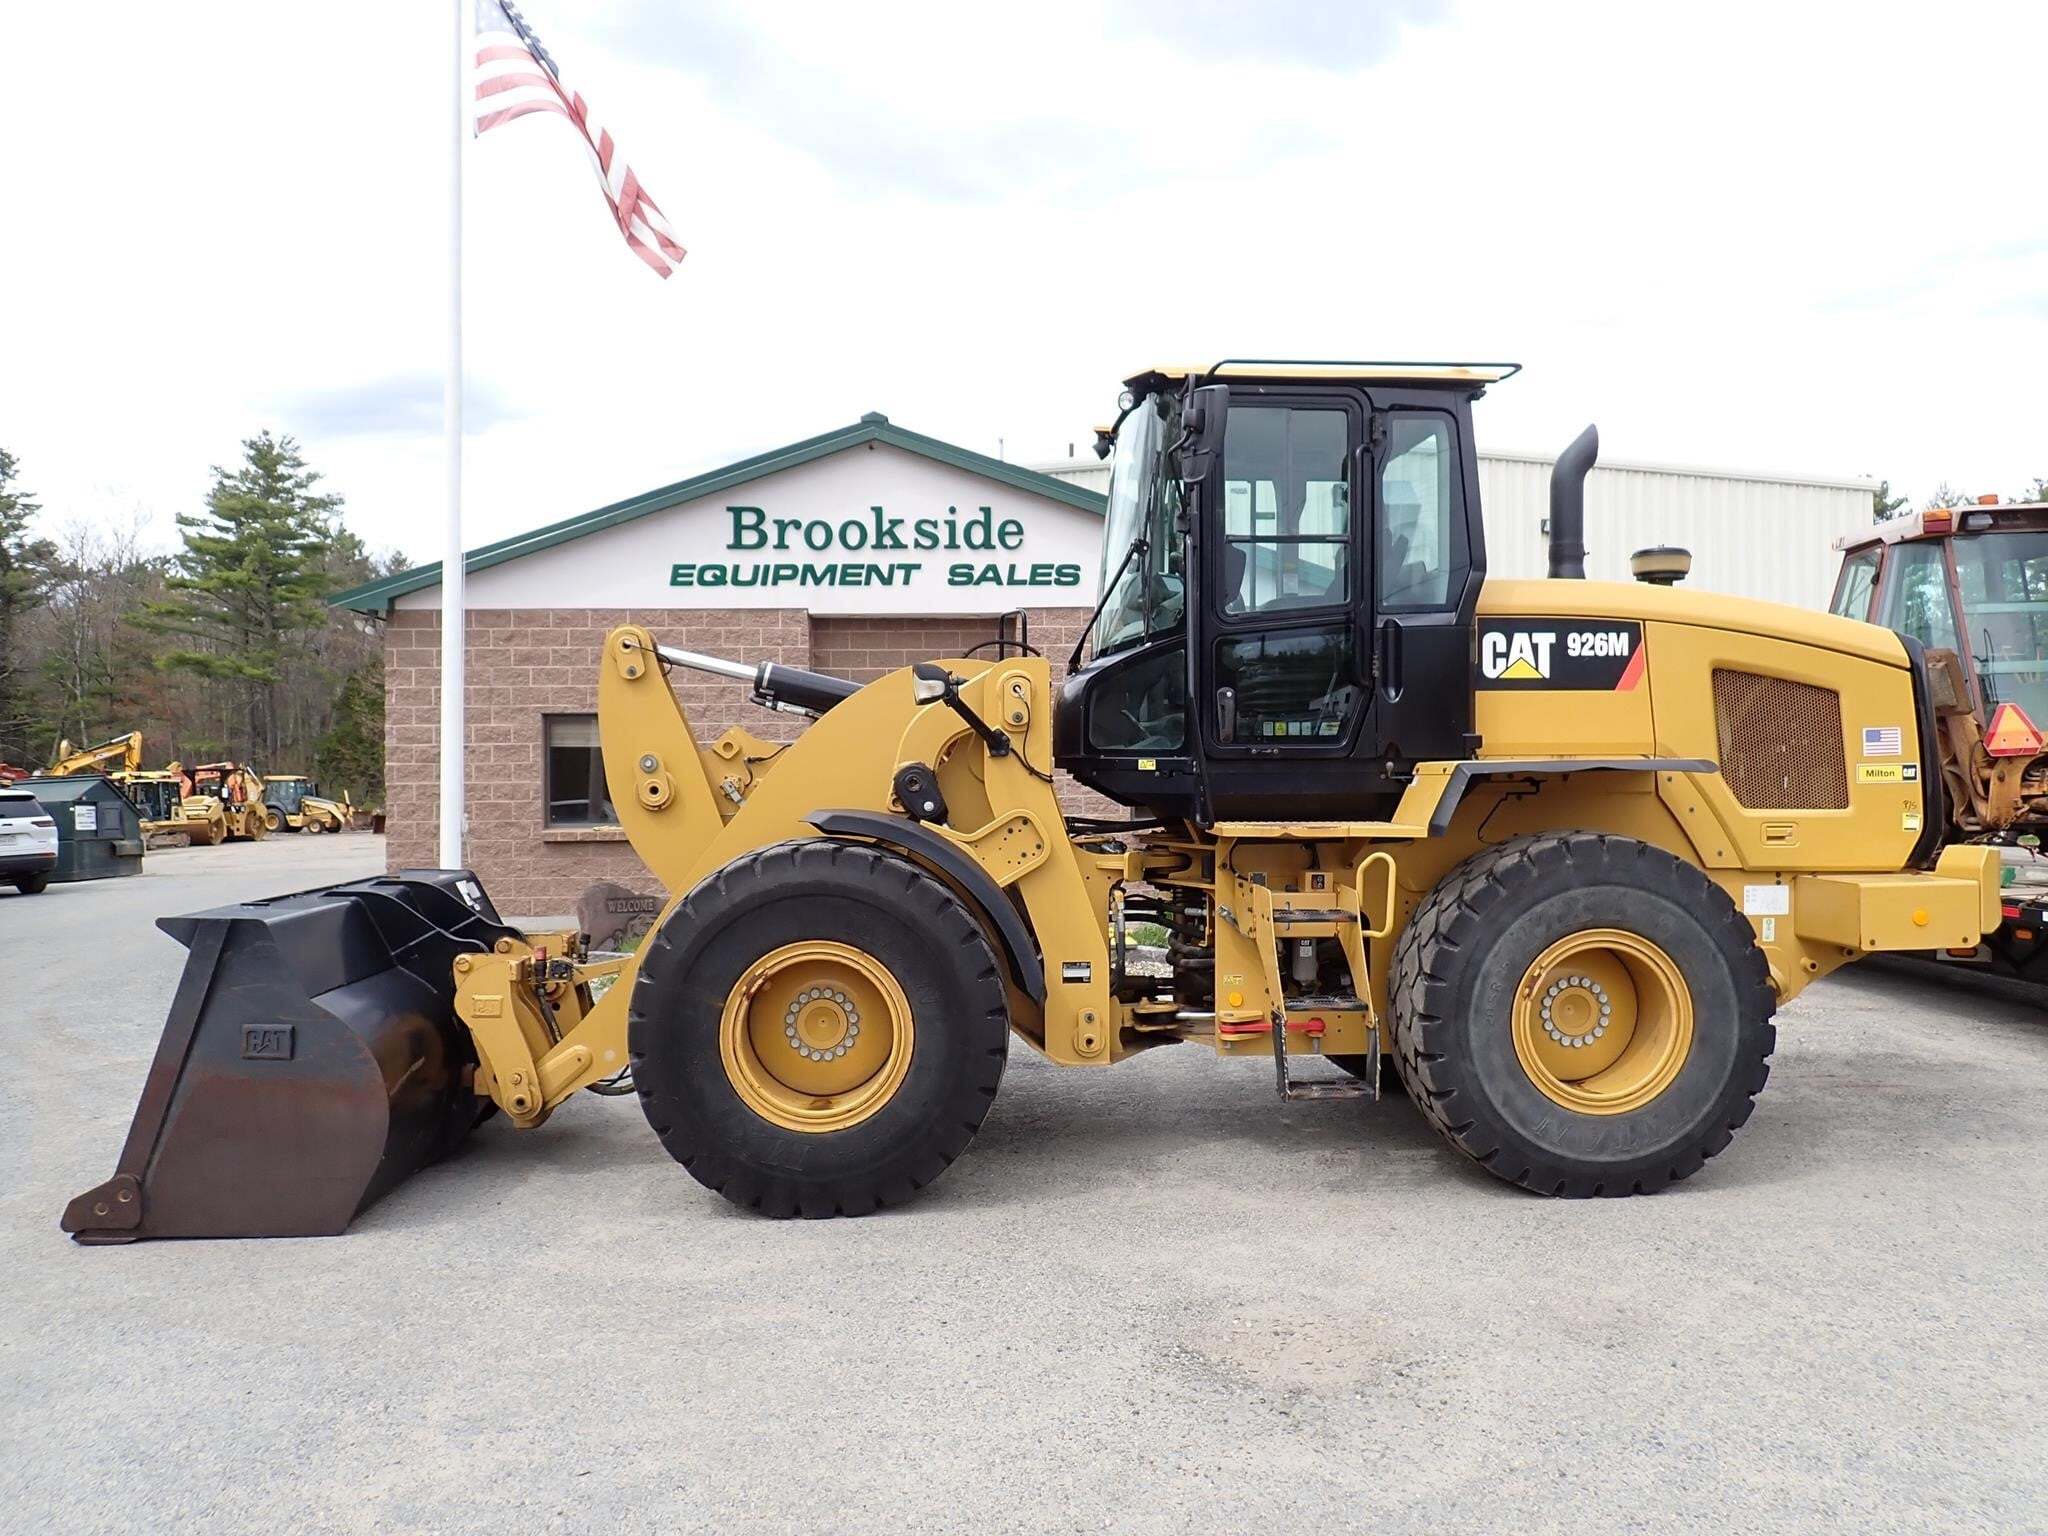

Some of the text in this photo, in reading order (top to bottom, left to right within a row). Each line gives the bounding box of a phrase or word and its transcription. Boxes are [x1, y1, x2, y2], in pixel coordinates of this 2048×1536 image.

[726, 506, 1024, 551] Brookside
[669, 563, 1081, 587] EQUIPMENT SALES
[1482, 631, 1629, 679] CAT 926M
[1865, 769, 1895, 777] Milton
[608, 900, 655, 914] WELCOME
[246, 1030, 288, 1055] CAT
